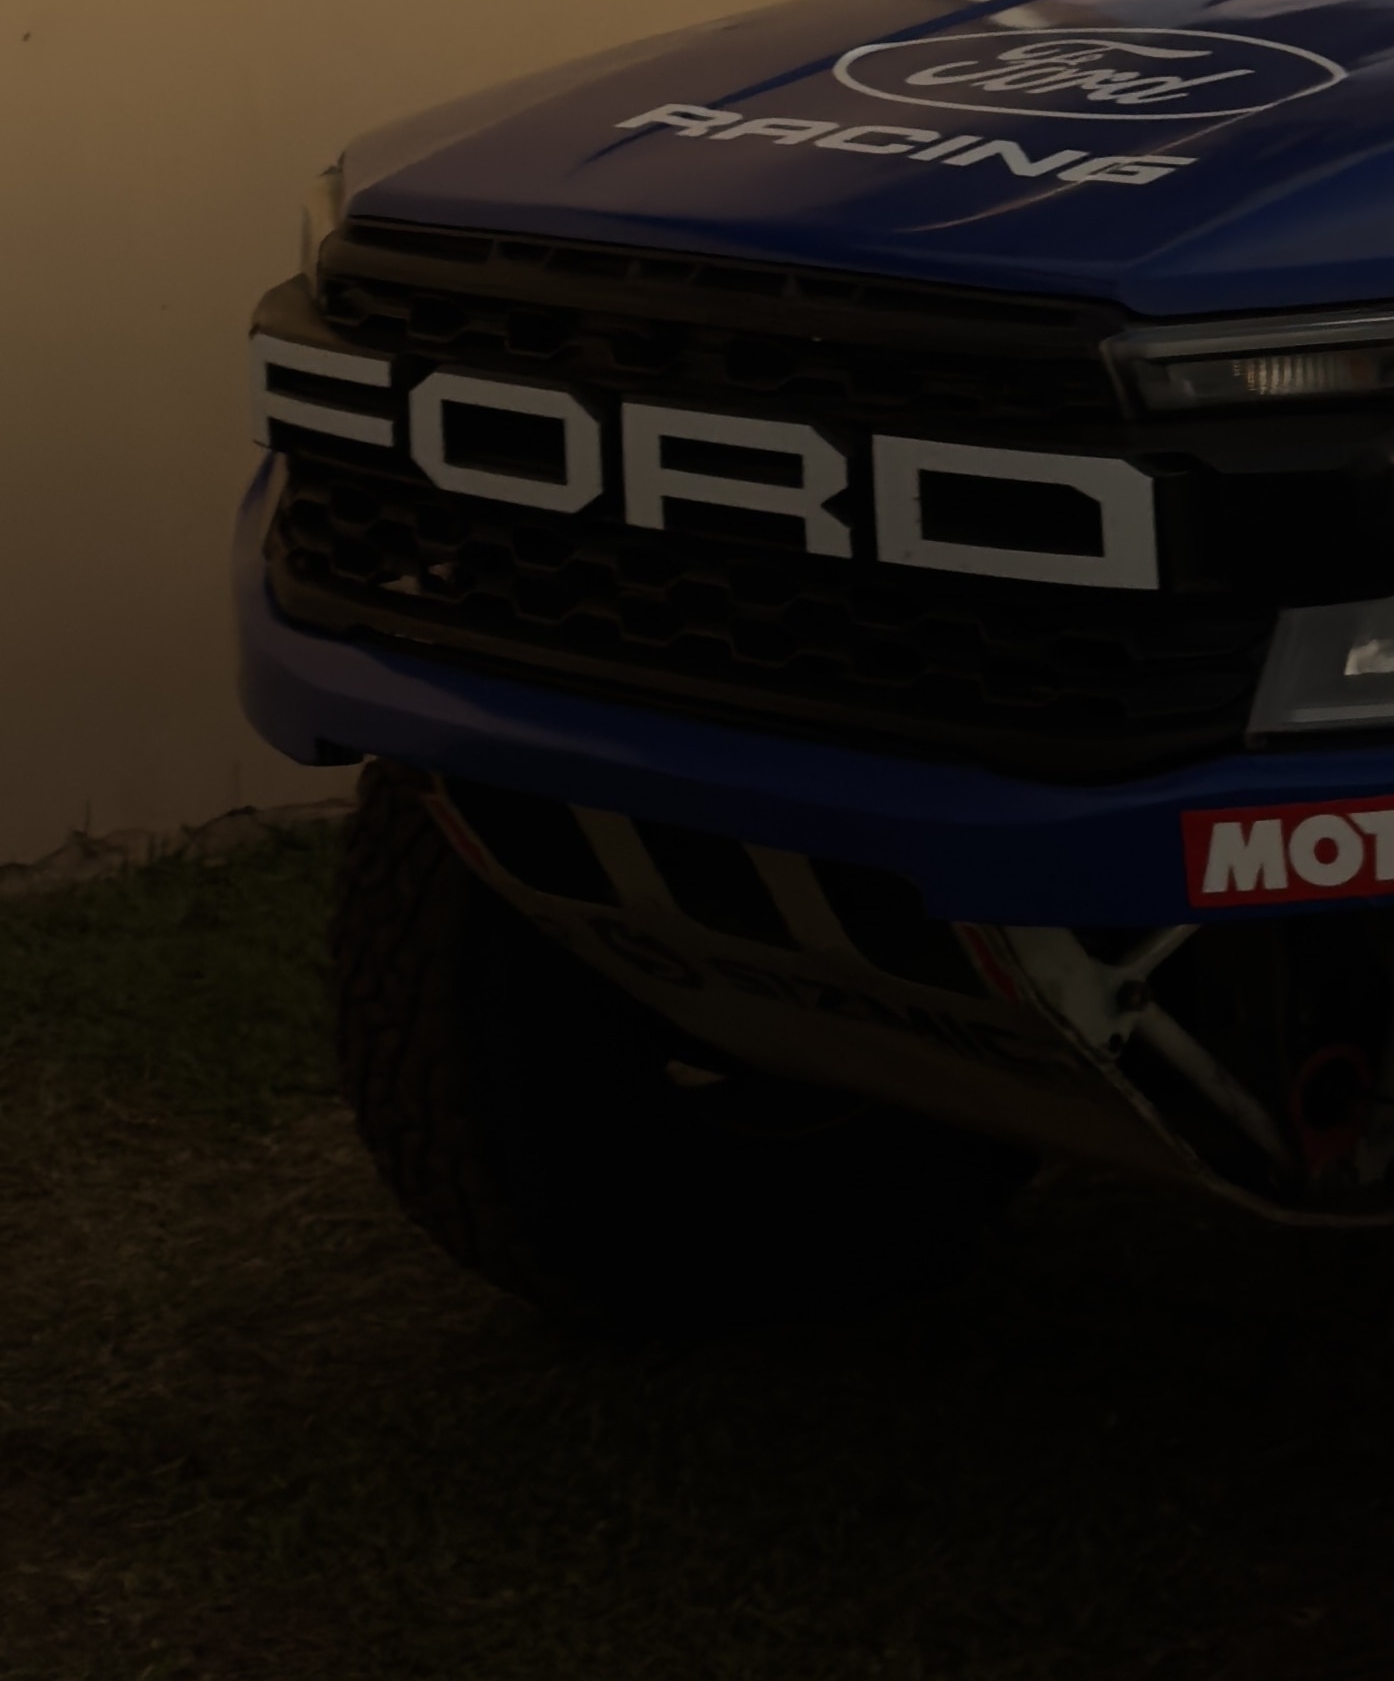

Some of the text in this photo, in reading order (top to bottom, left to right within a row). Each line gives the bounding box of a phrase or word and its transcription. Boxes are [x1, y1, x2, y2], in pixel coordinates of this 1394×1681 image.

[903, 37, 1257, 105] Ford
[613, 102, 1200, 186] RACING
[250, 333, 1160, 591] FORD
